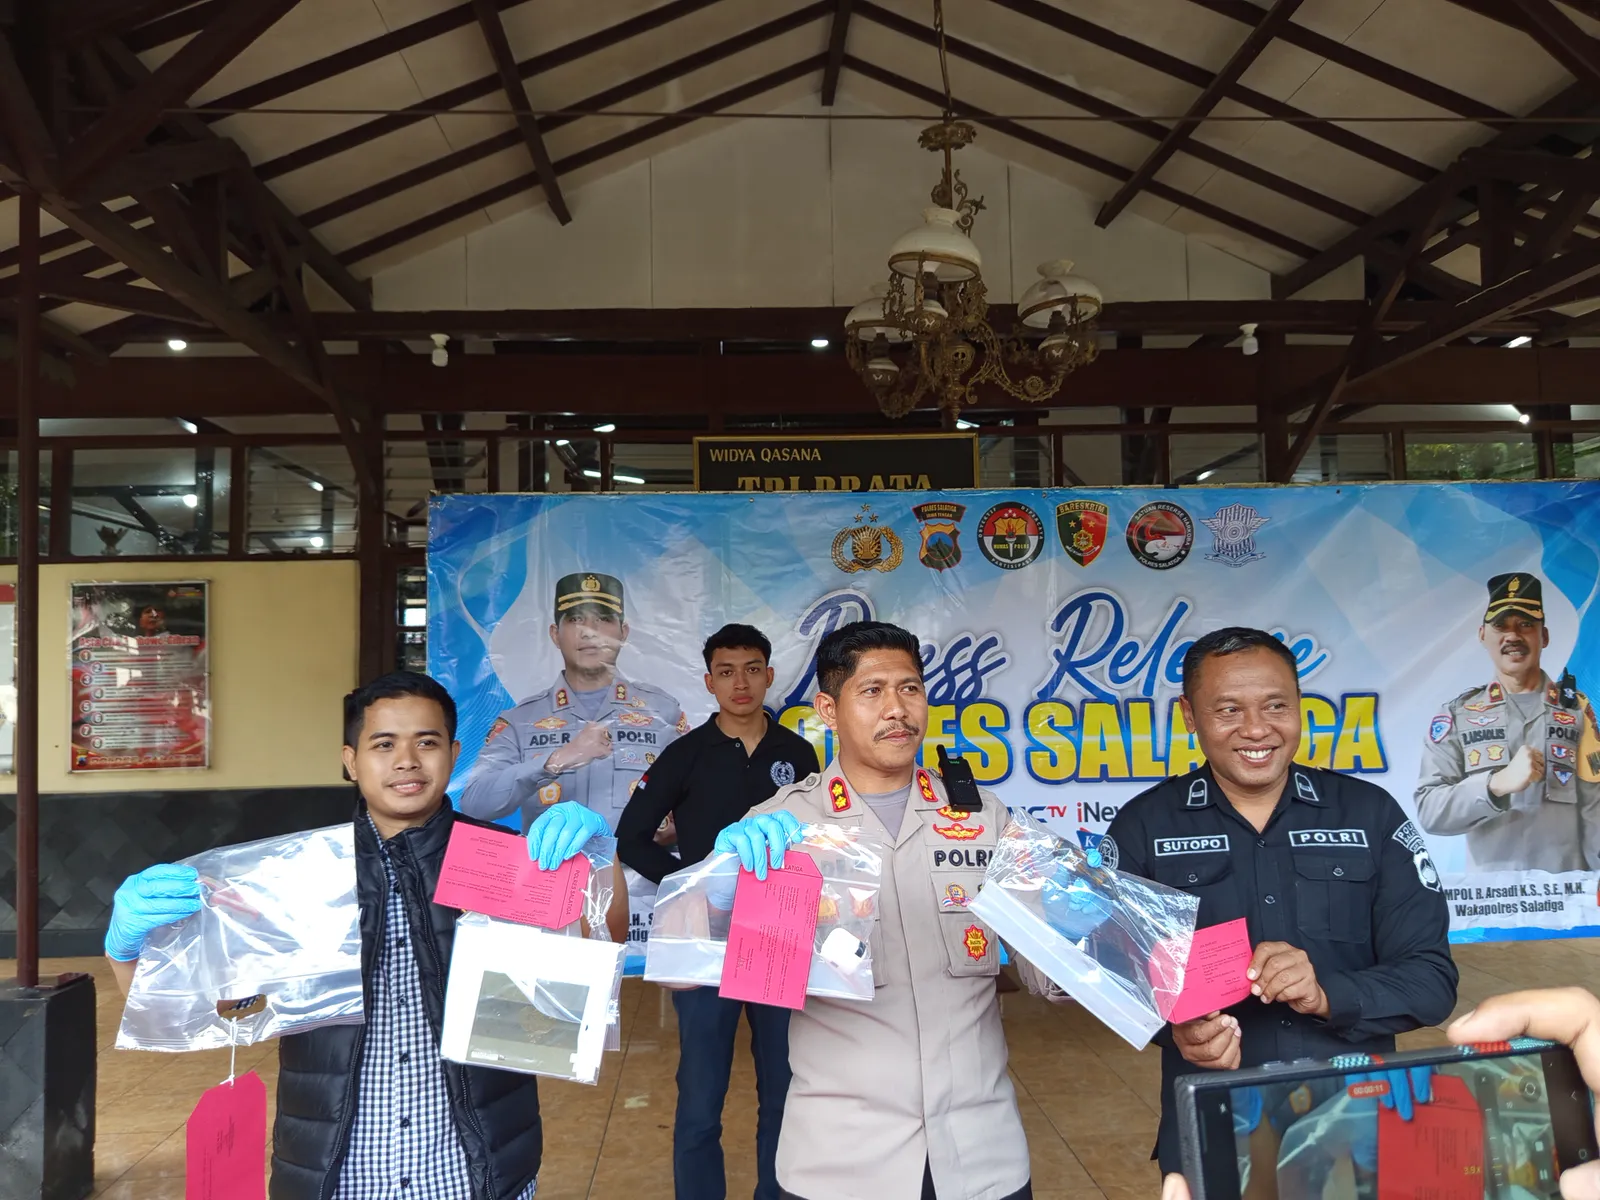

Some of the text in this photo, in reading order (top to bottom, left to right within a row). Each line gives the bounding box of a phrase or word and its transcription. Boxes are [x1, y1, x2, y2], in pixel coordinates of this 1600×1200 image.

[709, 447, 822, 462] WIDYA QASANA
[1059, 502, 1106, 513] BARESKRIM
[1134, 505, 1157, 521] SATUAN
[617, 731, 657, 744] POLRI
[1025, 693, 1389, 784] SALAGA
[1163, 832, 1358, 852] SUTOPO POLRI
[1485, 884, 1518, 899] Arsadi
[1455, 899, 1564, 917] Wakapolres Salatiga
